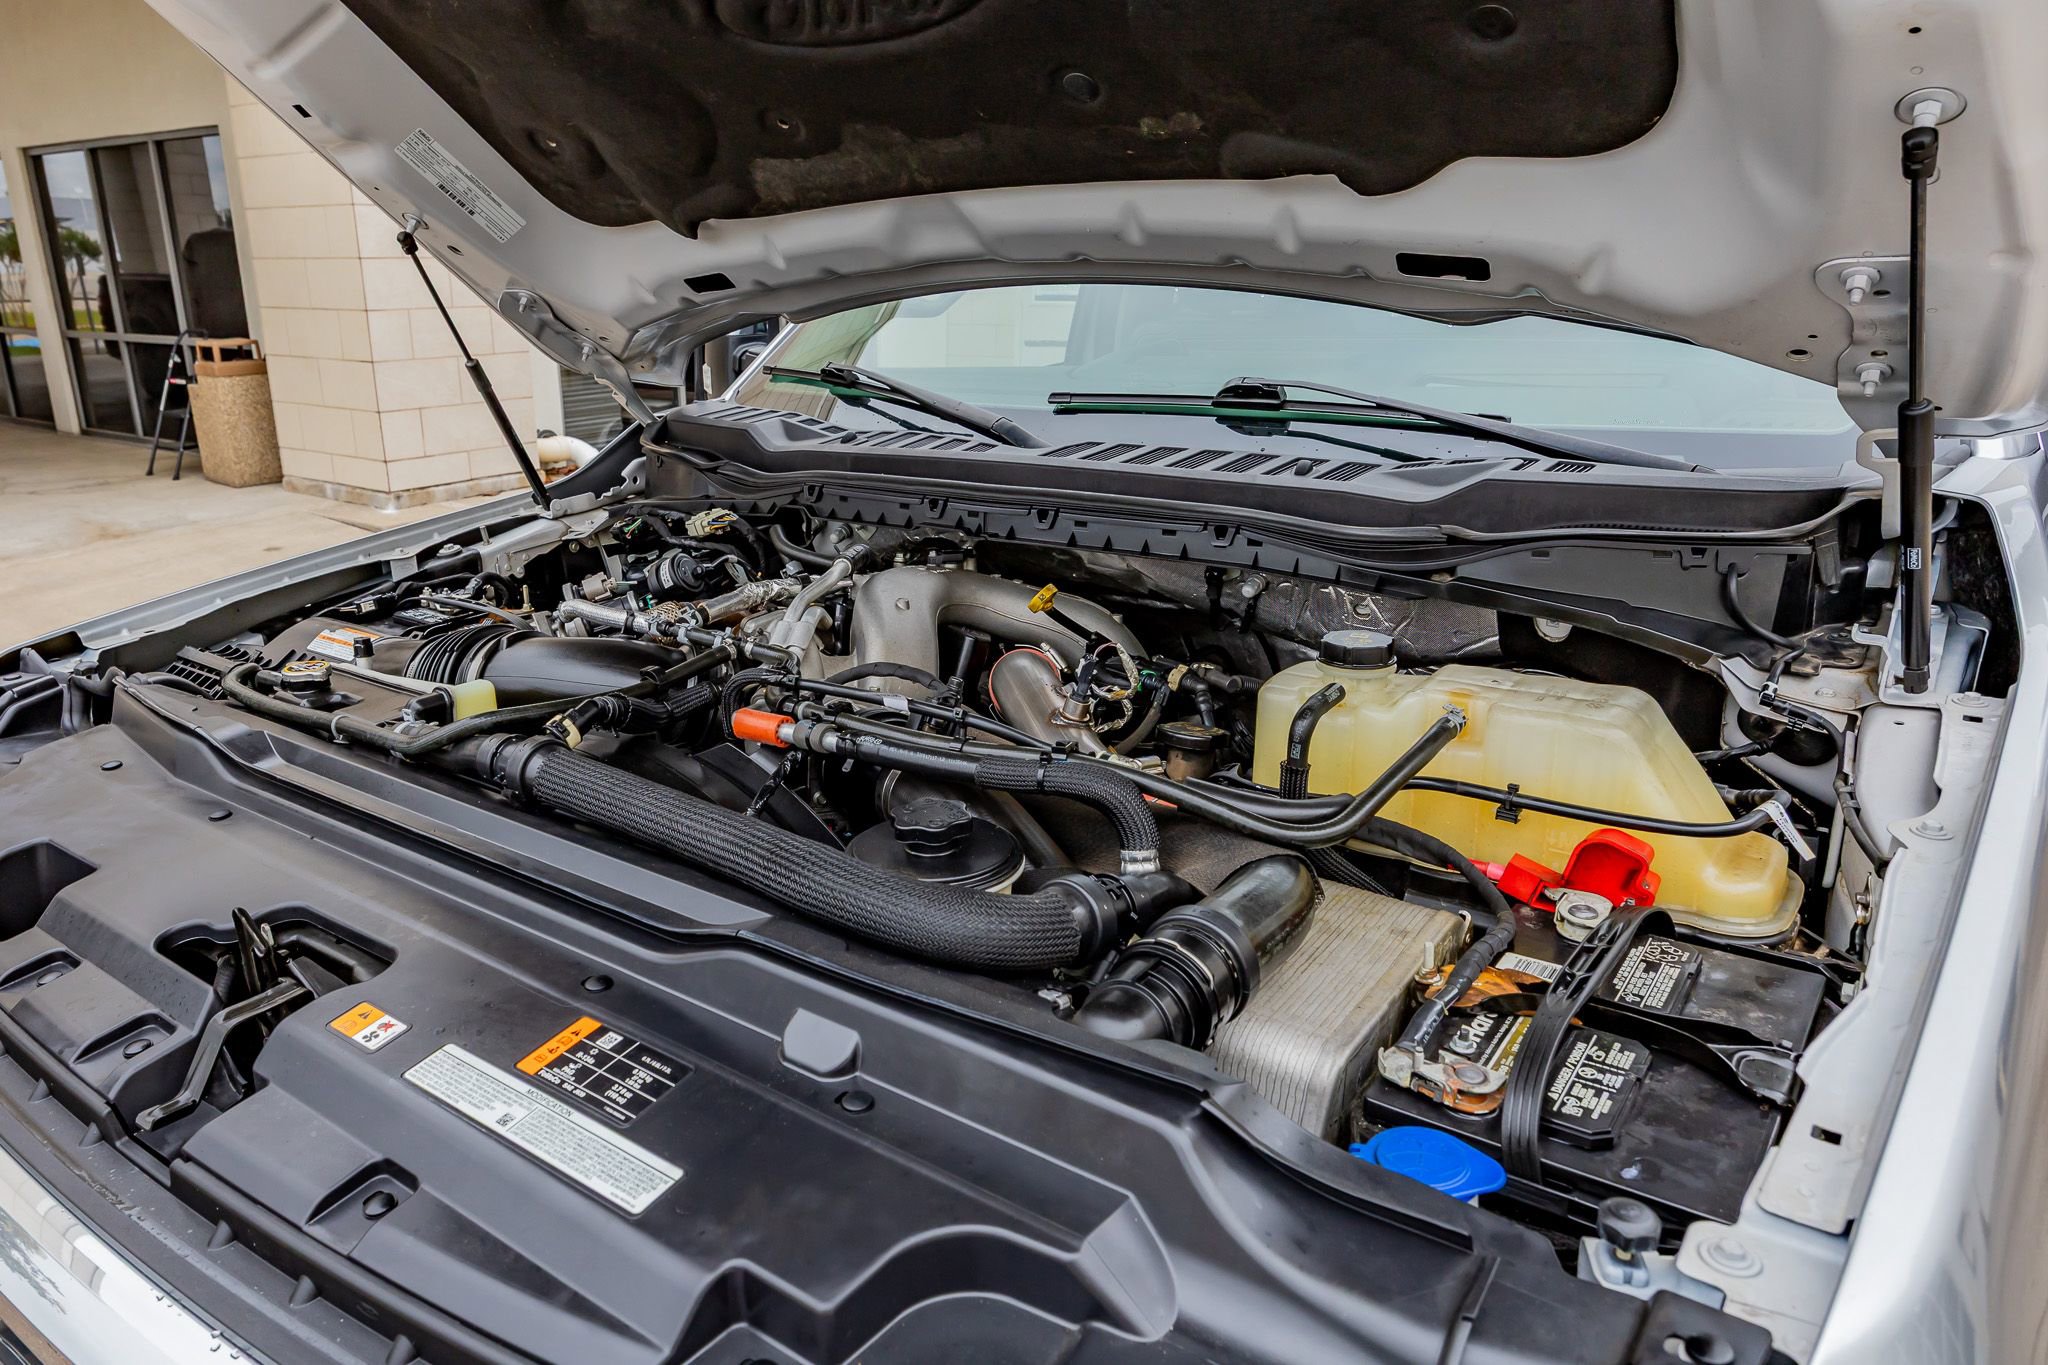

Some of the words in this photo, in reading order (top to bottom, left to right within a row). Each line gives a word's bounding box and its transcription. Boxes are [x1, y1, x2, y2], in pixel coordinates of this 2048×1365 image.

[538, 1069, 561, 1085] FoMoCo
[1550, 1067, 1574, 1094] DANGER
[1567, 1042, 1588, 1065] POISON
[526, 1088, 574, 1117] MODIFICATION
